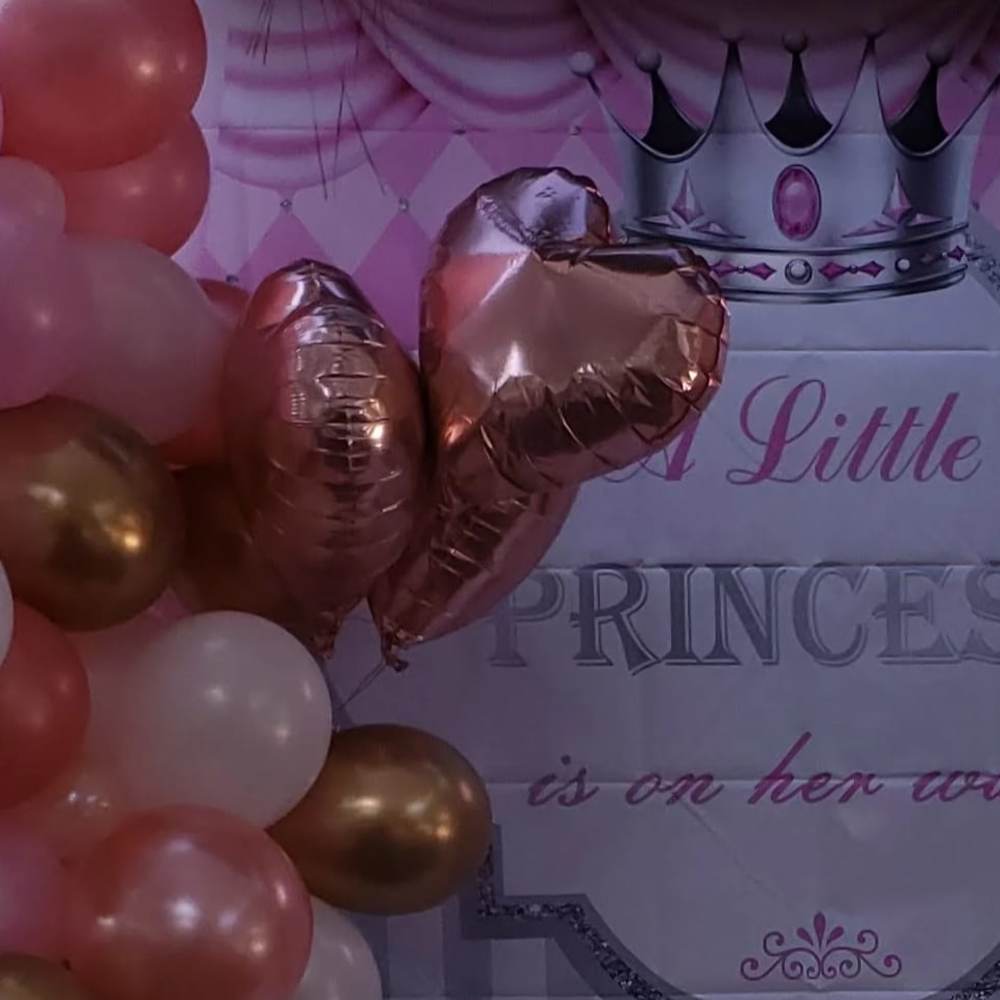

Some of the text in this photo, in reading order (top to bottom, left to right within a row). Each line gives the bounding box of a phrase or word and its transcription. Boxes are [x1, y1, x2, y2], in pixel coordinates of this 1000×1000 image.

[726, 374, 982, 485] Little
[527, 754, 598, 808] is
[622, 768, 727, 808] on
[747, 730, 885, 807] her
